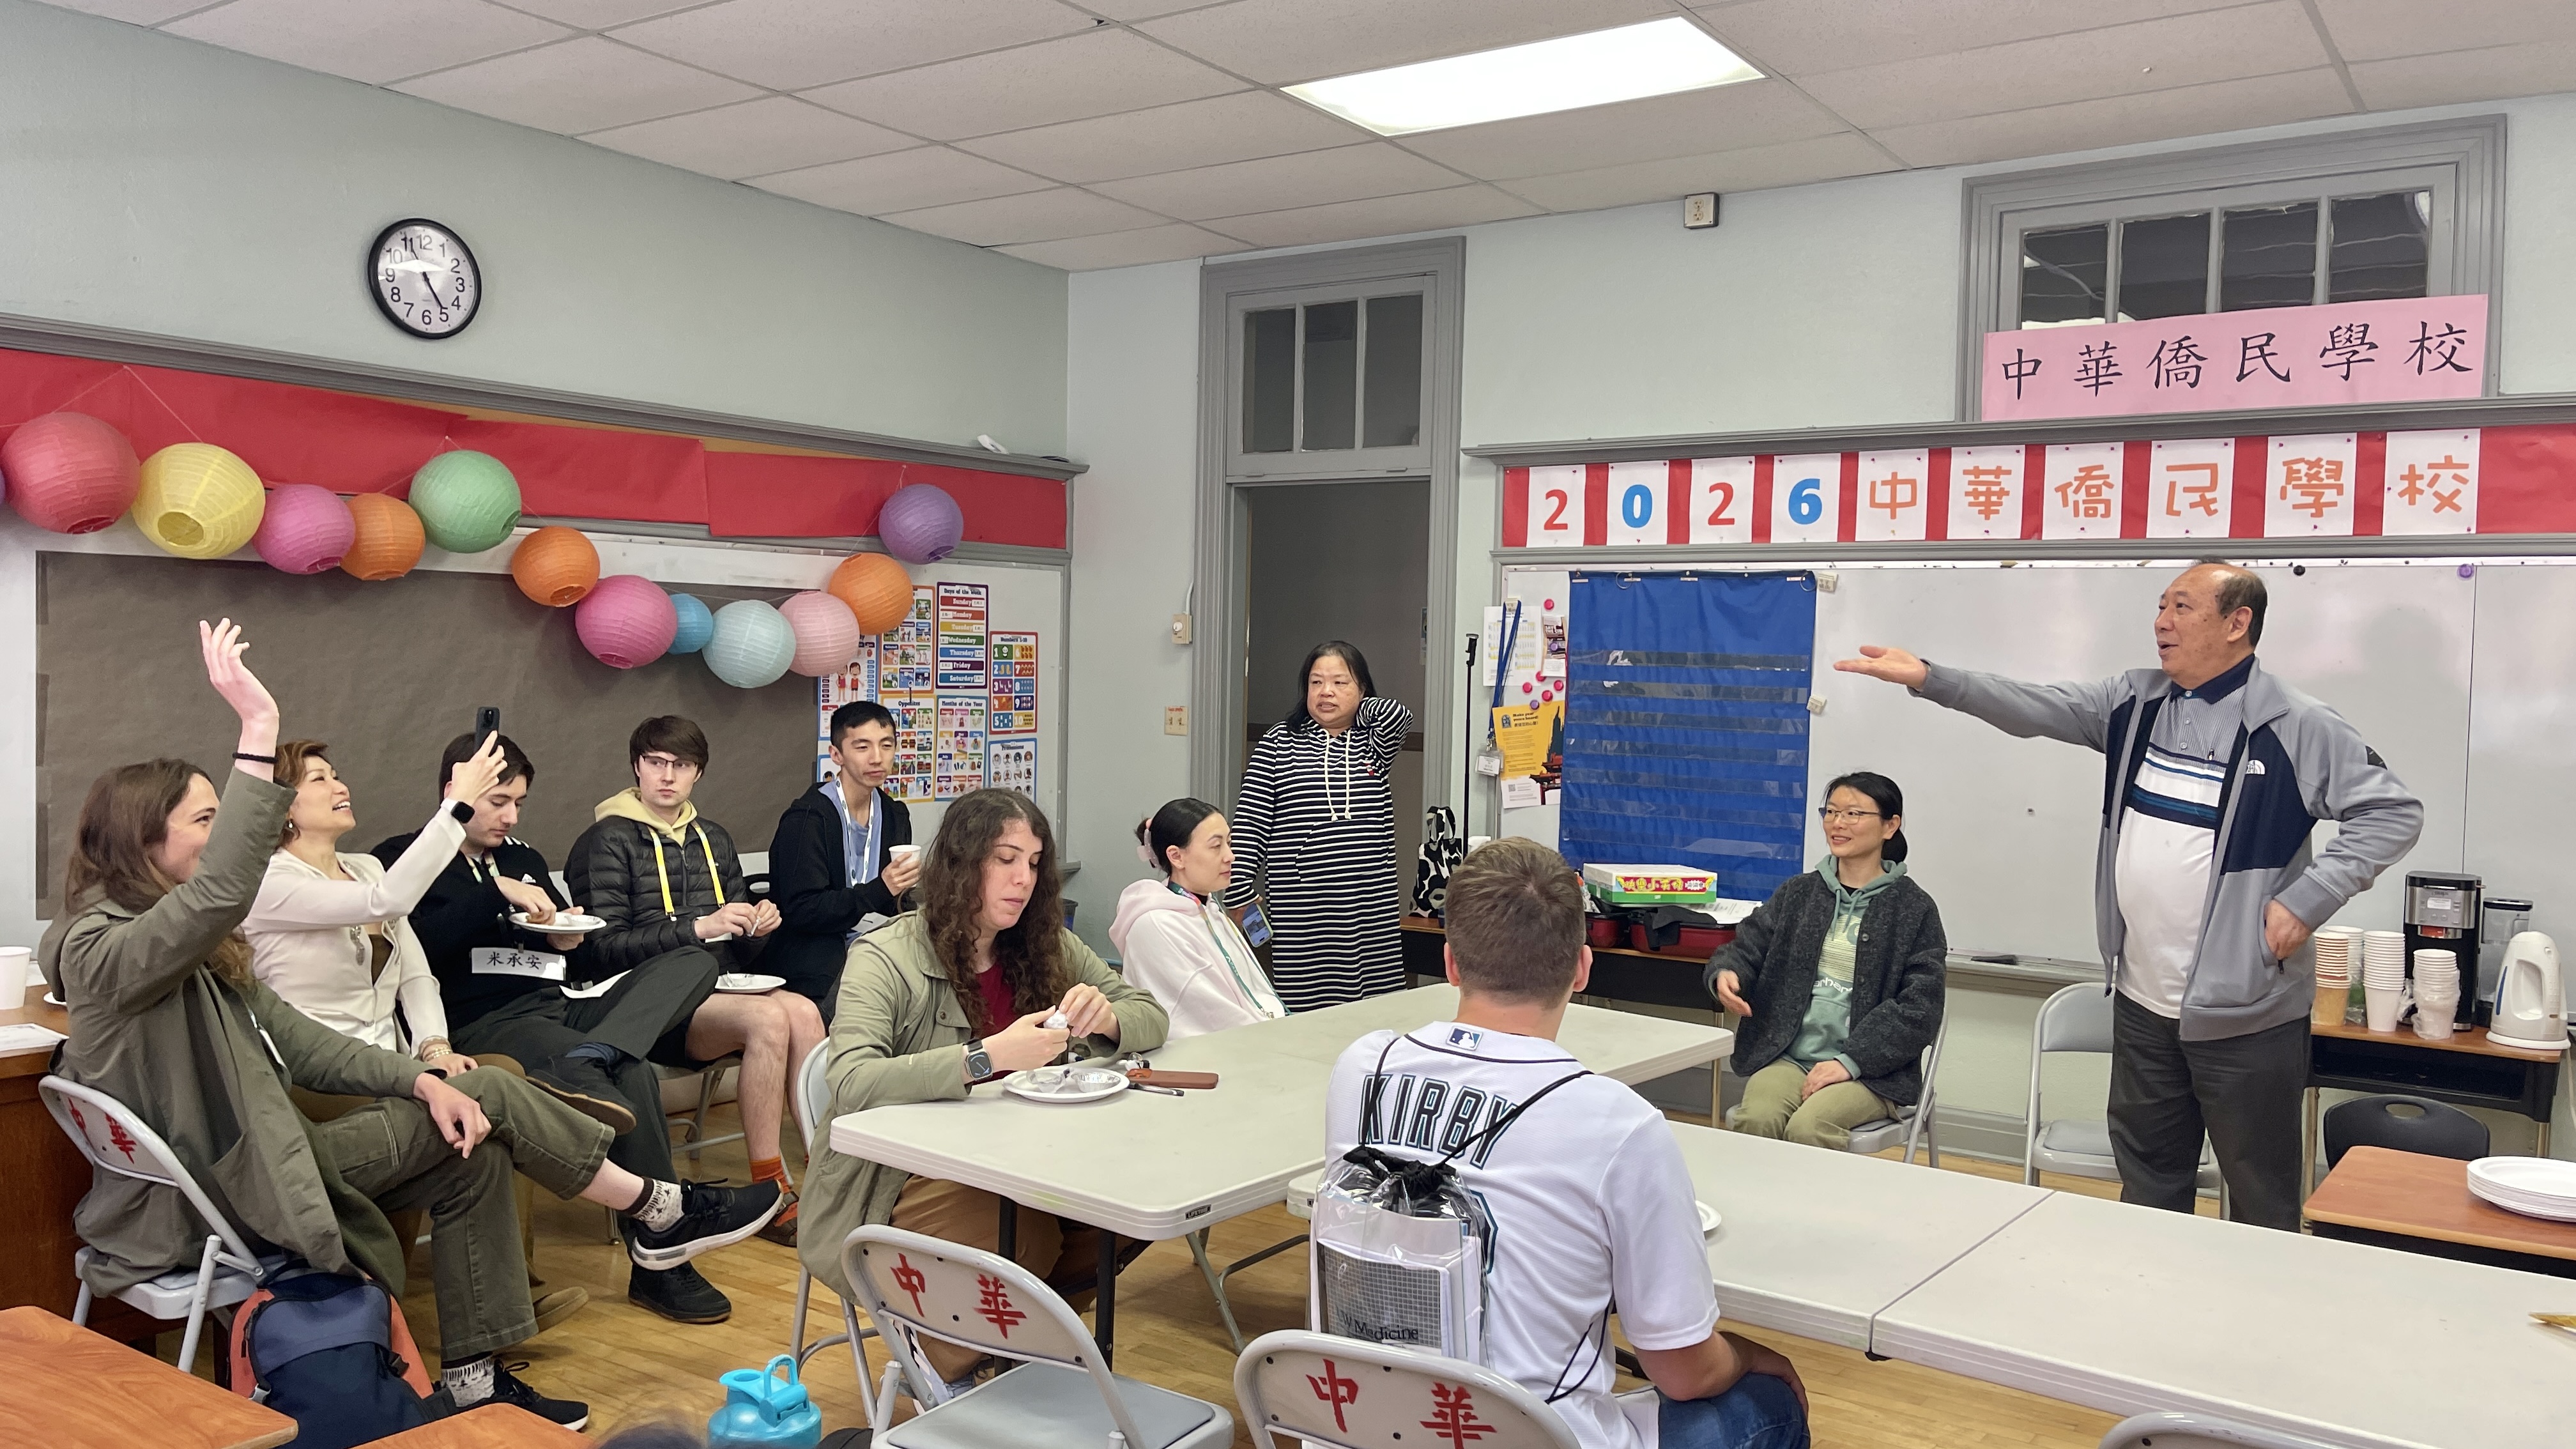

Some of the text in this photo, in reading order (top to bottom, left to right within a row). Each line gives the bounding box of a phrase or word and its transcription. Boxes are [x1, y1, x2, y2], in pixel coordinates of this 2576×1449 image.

[401, 236, 413, 252] 11
[417, 234, 433, 250] 12
[386, 248, 403, 264] 10
[439, 243, 445, 257] 1
[450, 258, 460, 273] 2
[385, 268, 395, 282] 9
[456, 277, 465, 293] 3
[390, 286, 401, 302] 8
[404, 302, 414, 318] 7
[451, 296, 461, 310] 4
[422, 310, 432, 325] 6
[440, 307, 449, 322] 5
[2002, 321, 2474, 400] 中華僑民學校
[993, 647, 999, 657] 1
[993, 664, 999, 674] 2
[1015, 664, 1020, 674] 7
[993, 682, 999, 691] 3
[1015, 682, 1020, 691] 8
[1015, 698, 1020, 709] 9
[994, 716, 999, 726] 5
[1014, 715, 1023, 726] 10
[1360, 1074, 1519, 1170] KIRBY
[891, 1252, 1027, 1339] 中華
[1354, 1319, 1419, 1340] Medicine
[1306, 1358, 1498, 1449] 中華
